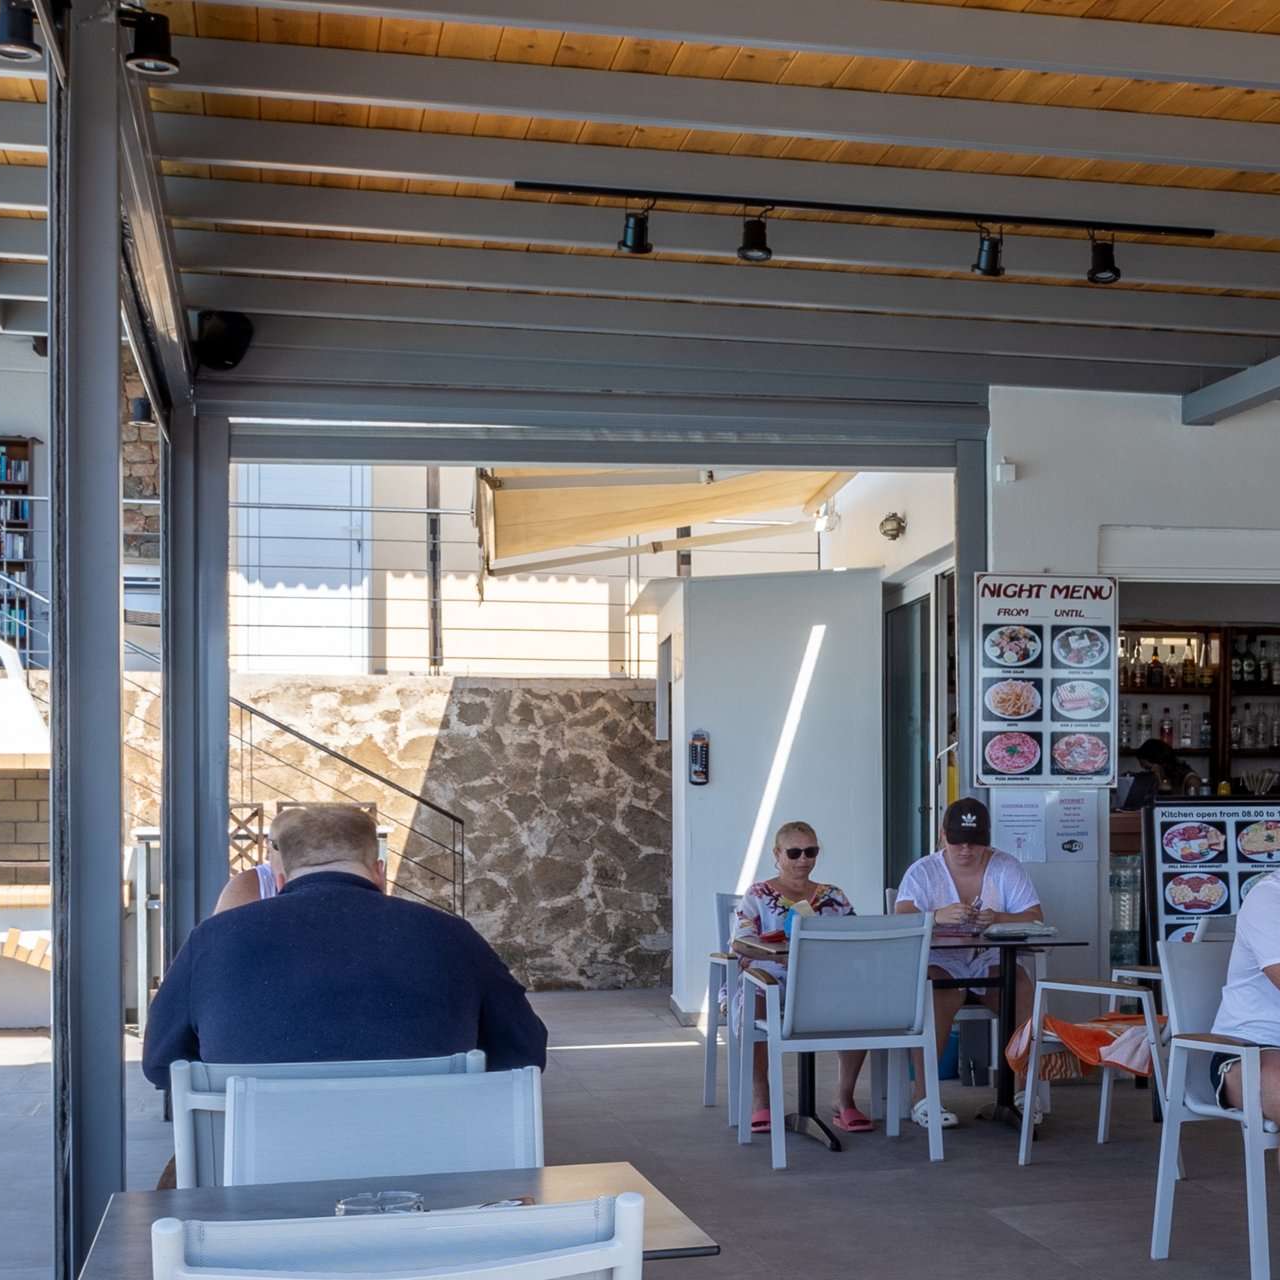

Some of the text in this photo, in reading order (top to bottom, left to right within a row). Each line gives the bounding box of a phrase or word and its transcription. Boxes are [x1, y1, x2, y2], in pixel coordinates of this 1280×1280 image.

[981, 583, 1113, 600] NIGHT MENU
[997, 608, 1085, 618] FROM UNTIL
[1160, 810, 1195, 818] Kitchen
[1196, 811, 1218, 820] open
[1220, 810, 1239, 818] from
[1241, 810, 1265, 818] 08.00
